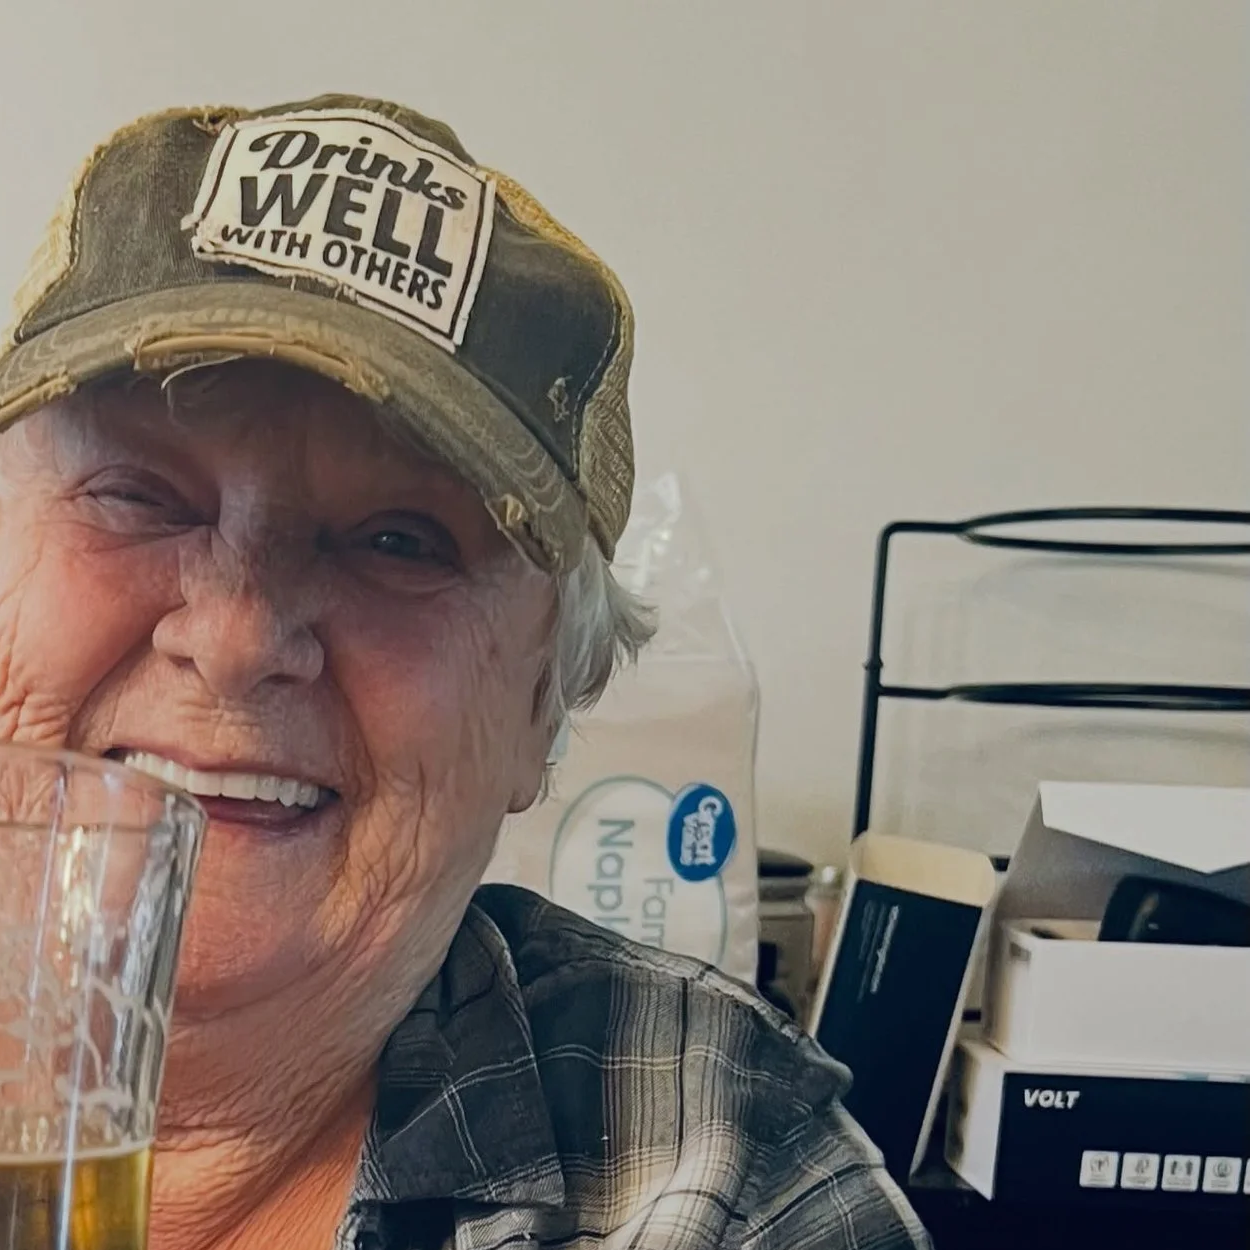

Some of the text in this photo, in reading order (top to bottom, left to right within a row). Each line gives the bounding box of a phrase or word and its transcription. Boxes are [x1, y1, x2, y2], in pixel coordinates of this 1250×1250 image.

[249, 130, 468, 210] Drinks
[239, 173, 453, 278] WELL
[221, 225, 447, 311] WITH OTHERS
[1023, 1088, 1081, 1110] VOLT
